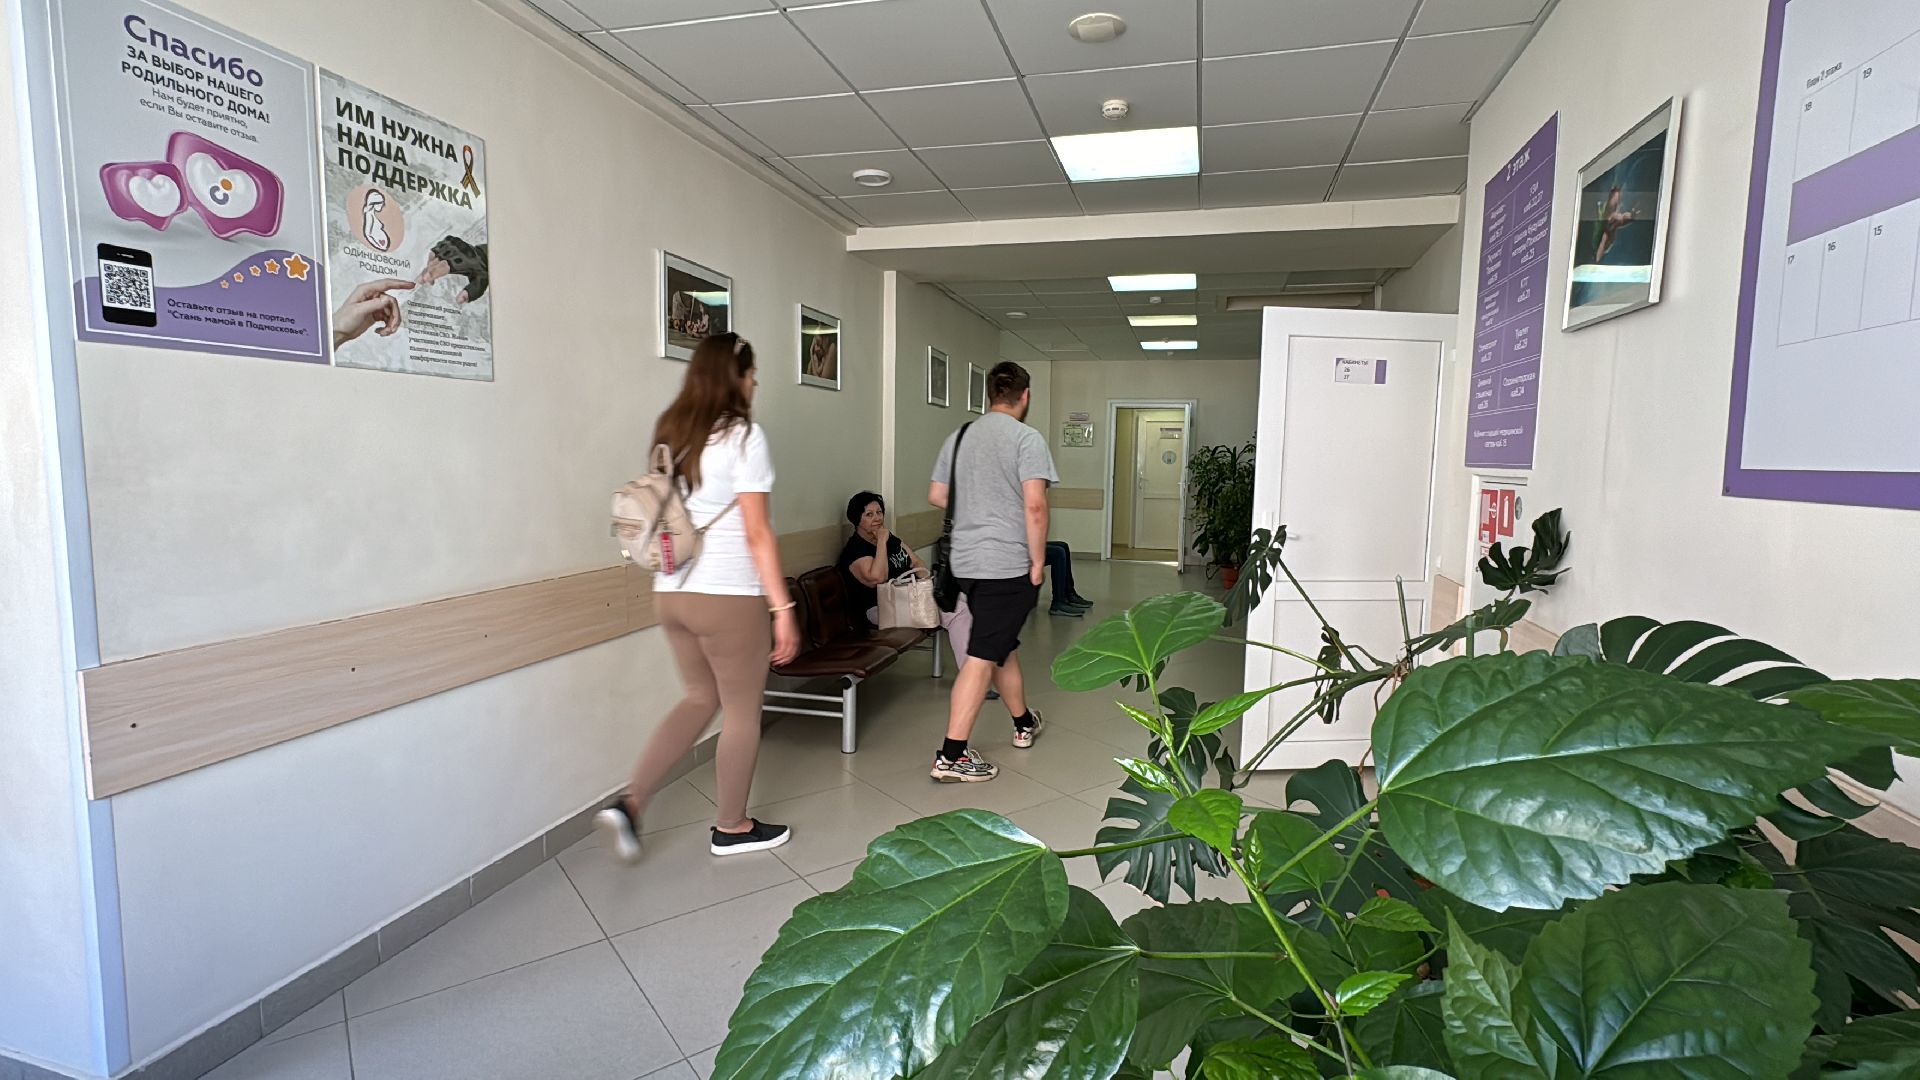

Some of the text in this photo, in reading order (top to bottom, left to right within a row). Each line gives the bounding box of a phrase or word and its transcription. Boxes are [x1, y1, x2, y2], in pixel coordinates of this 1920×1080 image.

[124, 14, 264, 87] Спасибо
[127, 45, 264, 105] ЗА ВЫБОР НАШЕГО
[1863, 67, 1873, 80] 19
[121, 61, 271, 124] РОДИЛЬНОГО ДОМА!
[1803, 101, 1813, 112] 18
[139, 98, 165, 112] если
[167, 106, 183, 118] Вы
[185, 113, 229, 133] оставите
[152, 88, 248, 128] Нам будет приятно,
[336, 97, 458, 163] ИМ НУЖНА
[337, 123, 408, 166] НАША
[1512, 147, 1531, 177] этаж
[338, 147, 472, 210] ПОДДЕРЖКА
[1874, 225, 1883, 236] 15
[343, 246, 411, 269] ОДИНЦОВСКИЙ
[1787, 254, 1796, 264] 17
[1827, 242, 1837, 252] 16
[359, 260, 398, 276] РОДДОМ
[167, 298, 295, 324] Оставьте отзыв на портале
[205, 317, 236, 326] мамой
